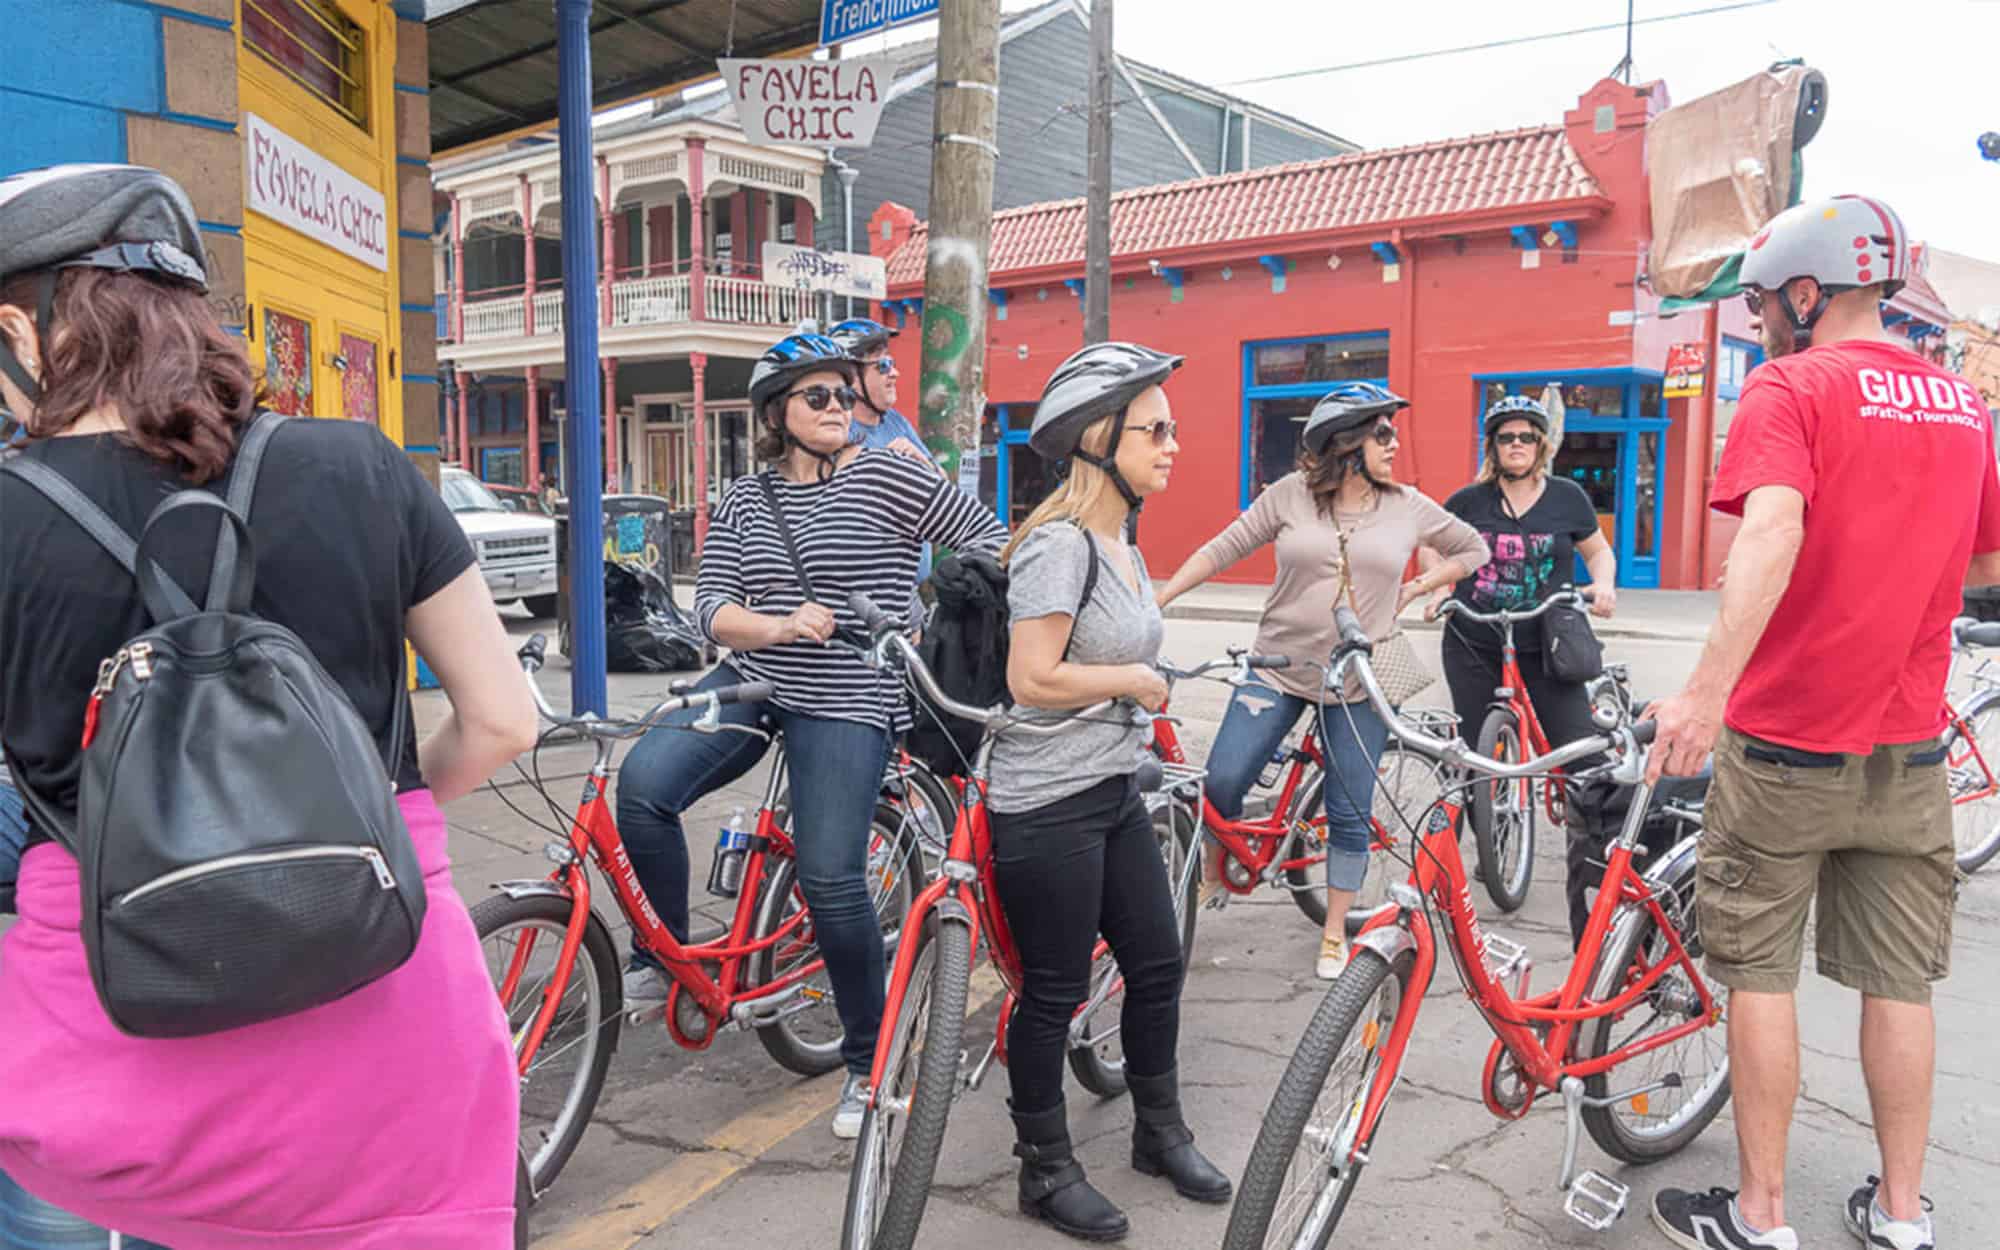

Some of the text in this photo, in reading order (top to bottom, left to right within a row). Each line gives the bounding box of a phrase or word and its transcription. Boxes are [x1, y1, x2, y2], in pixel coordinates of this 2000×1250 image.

[739, 64, 878, 101] FAVELA
[764, 105, 854, 141] CHIC
[253, 127, 384, 255] FAVELA CHIC
[1857, 368, 1979, 417] GUIDE
